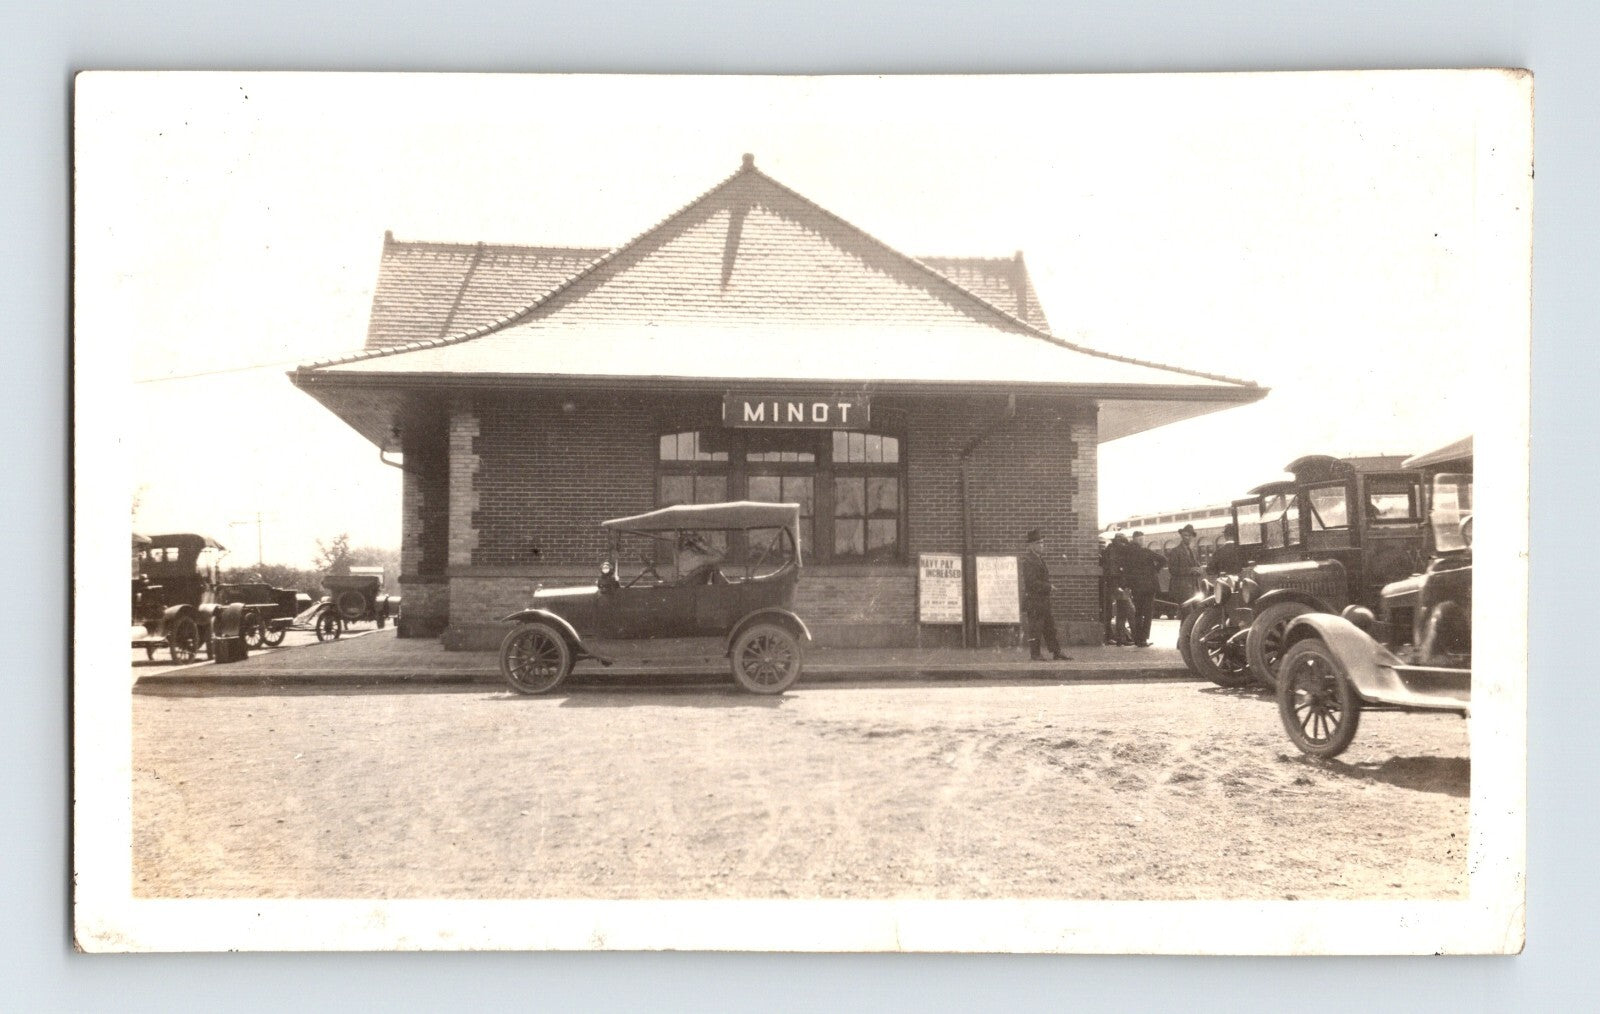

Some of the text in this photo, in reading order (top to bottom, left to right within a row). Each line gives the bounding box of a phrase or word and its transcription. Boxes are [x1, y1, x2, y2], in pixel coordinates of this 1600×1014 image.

[743, 401, 852, 423] MINOT
[920, 558, 953, 569] NAVY PAY
[925, 569, 960, 578] INCREASED
